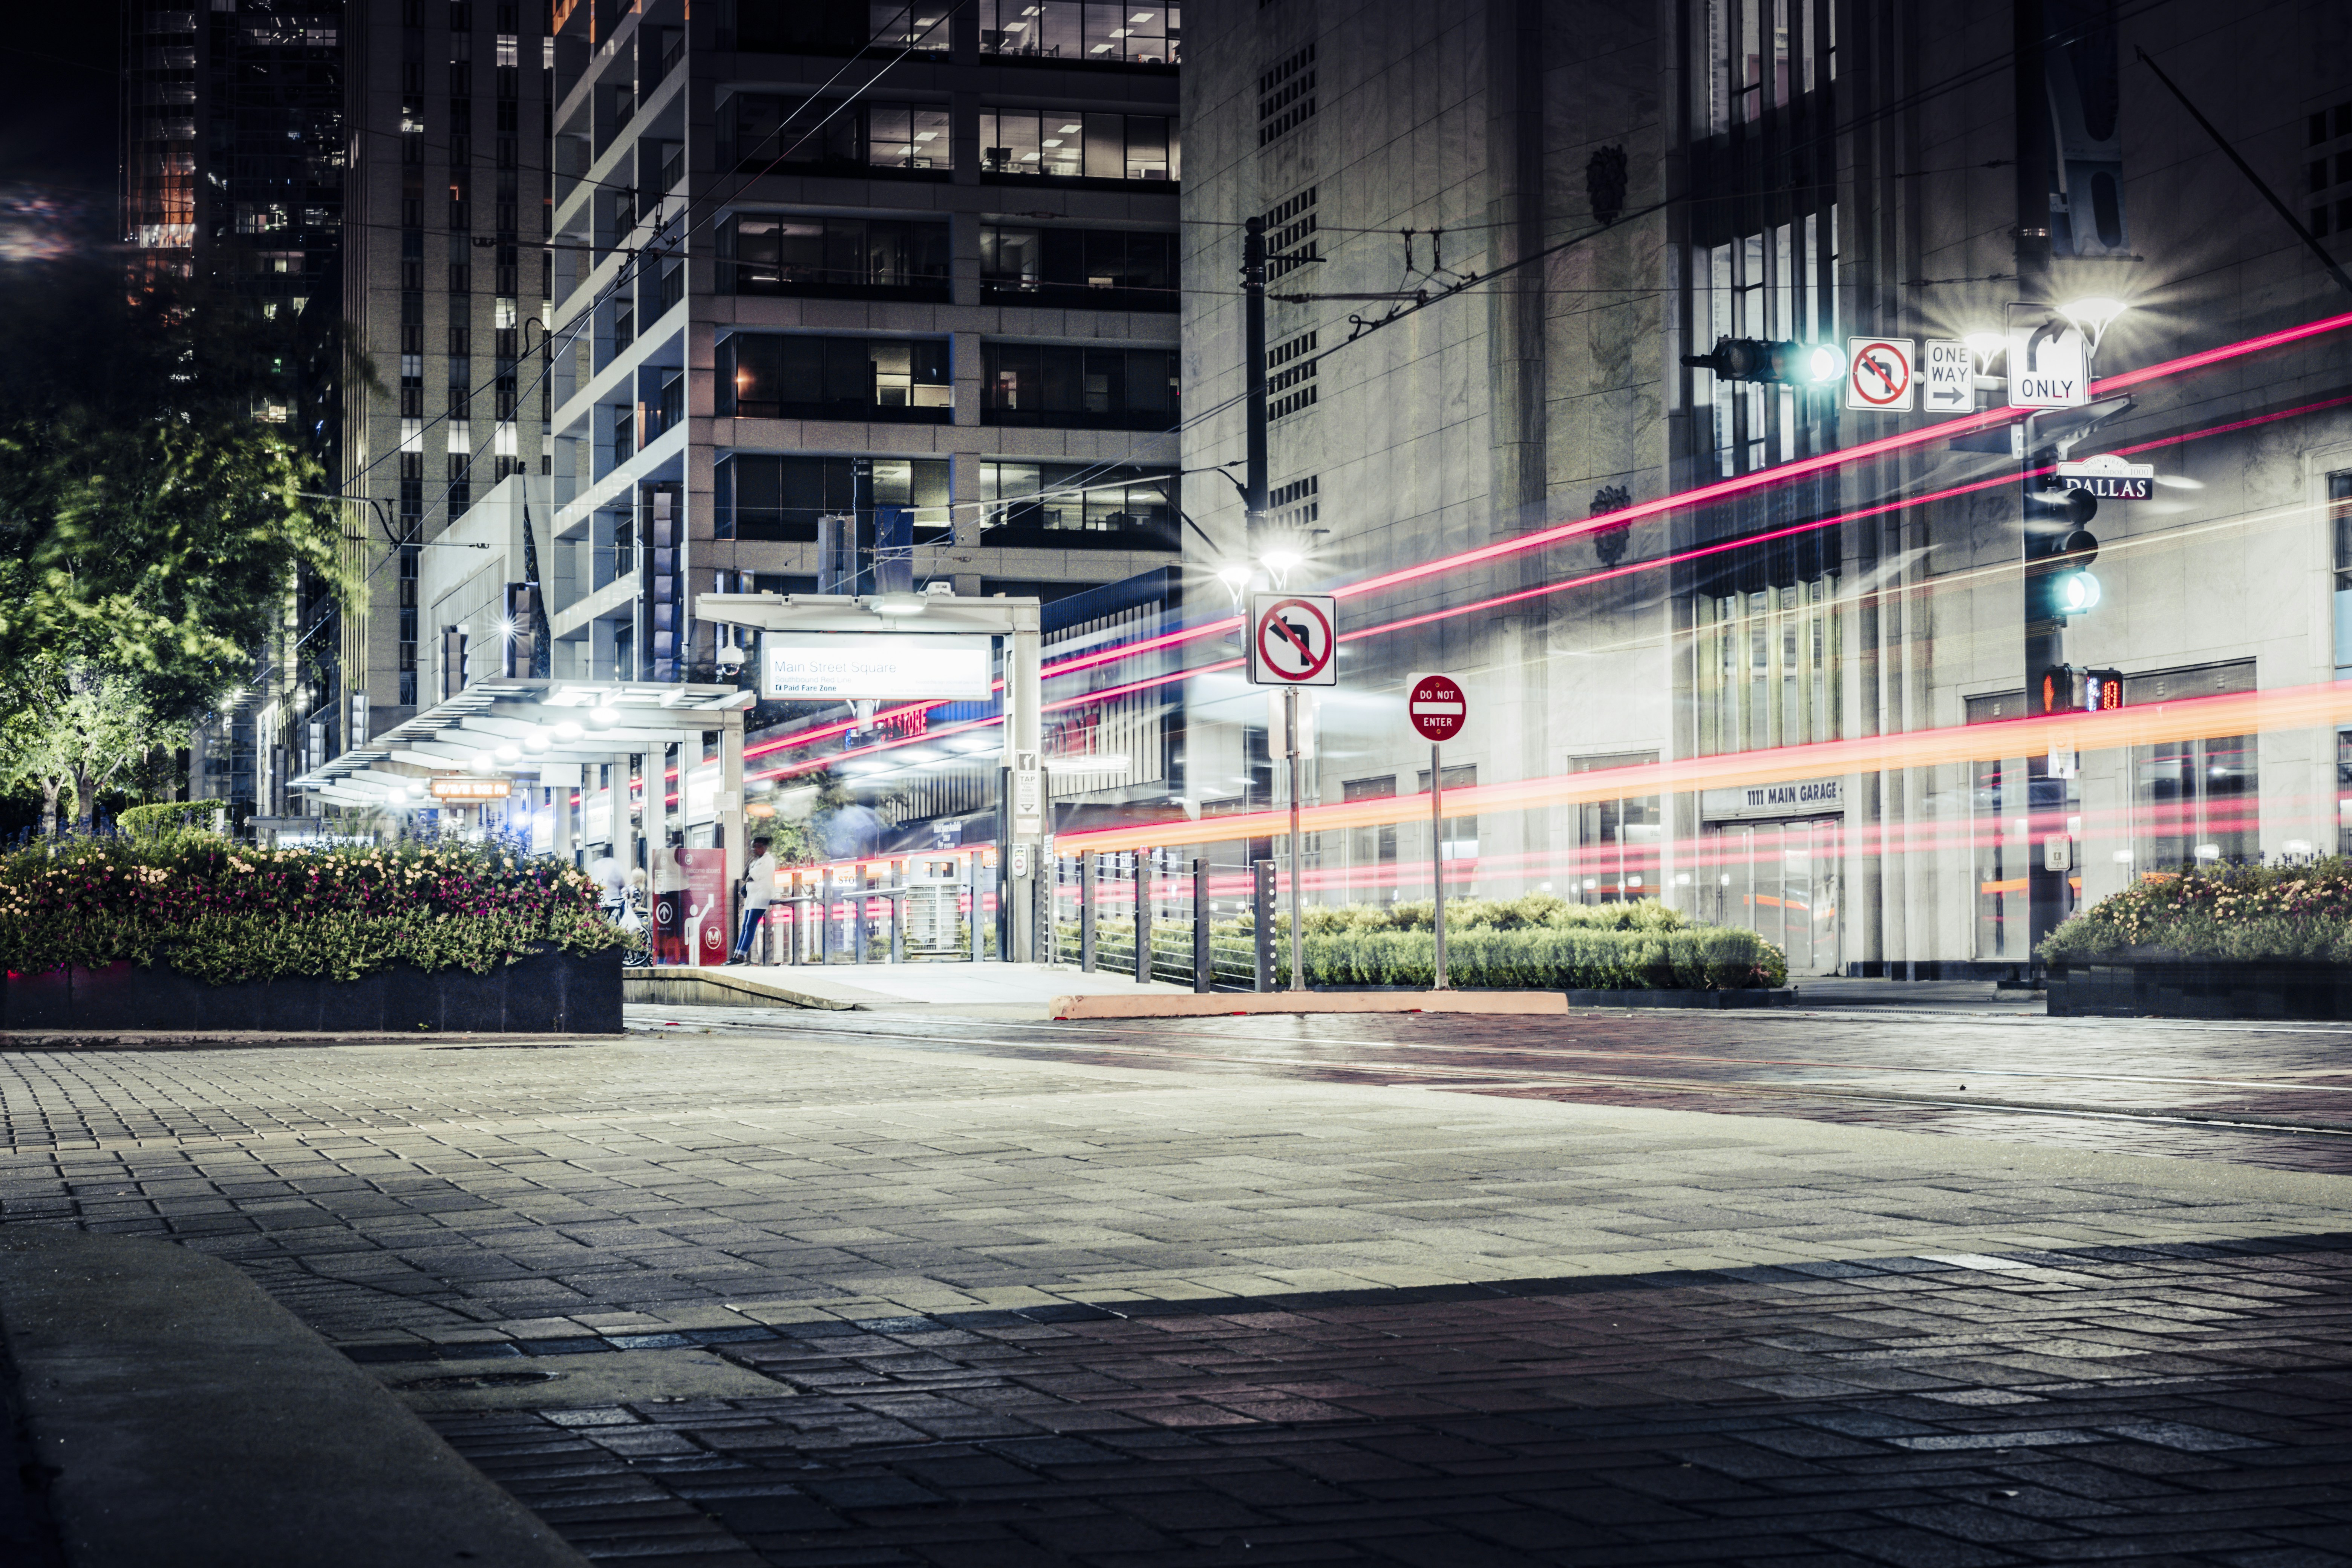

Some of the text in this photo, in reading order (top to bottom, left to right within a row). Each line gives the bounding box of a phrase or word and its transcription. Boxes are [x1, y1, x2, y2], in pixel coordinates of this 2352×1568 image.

[1933, 347, 1968, 363] ONE
[1932, 367, 1968, 382] WAY
[2022, 379, 2073, 398] ONLY
[2084, 458, 2127, 470] MAIN STREET
[2066, 478, 2145, 497] DALLAS
[775, 661, 896, 675] Main Street Square
[1420, 690, 1454, 700] DO NOT
[1424, 718, 1452, 727] ENTER
[1747, 782, 1836, 805] 1111 MAIN GARAGE
